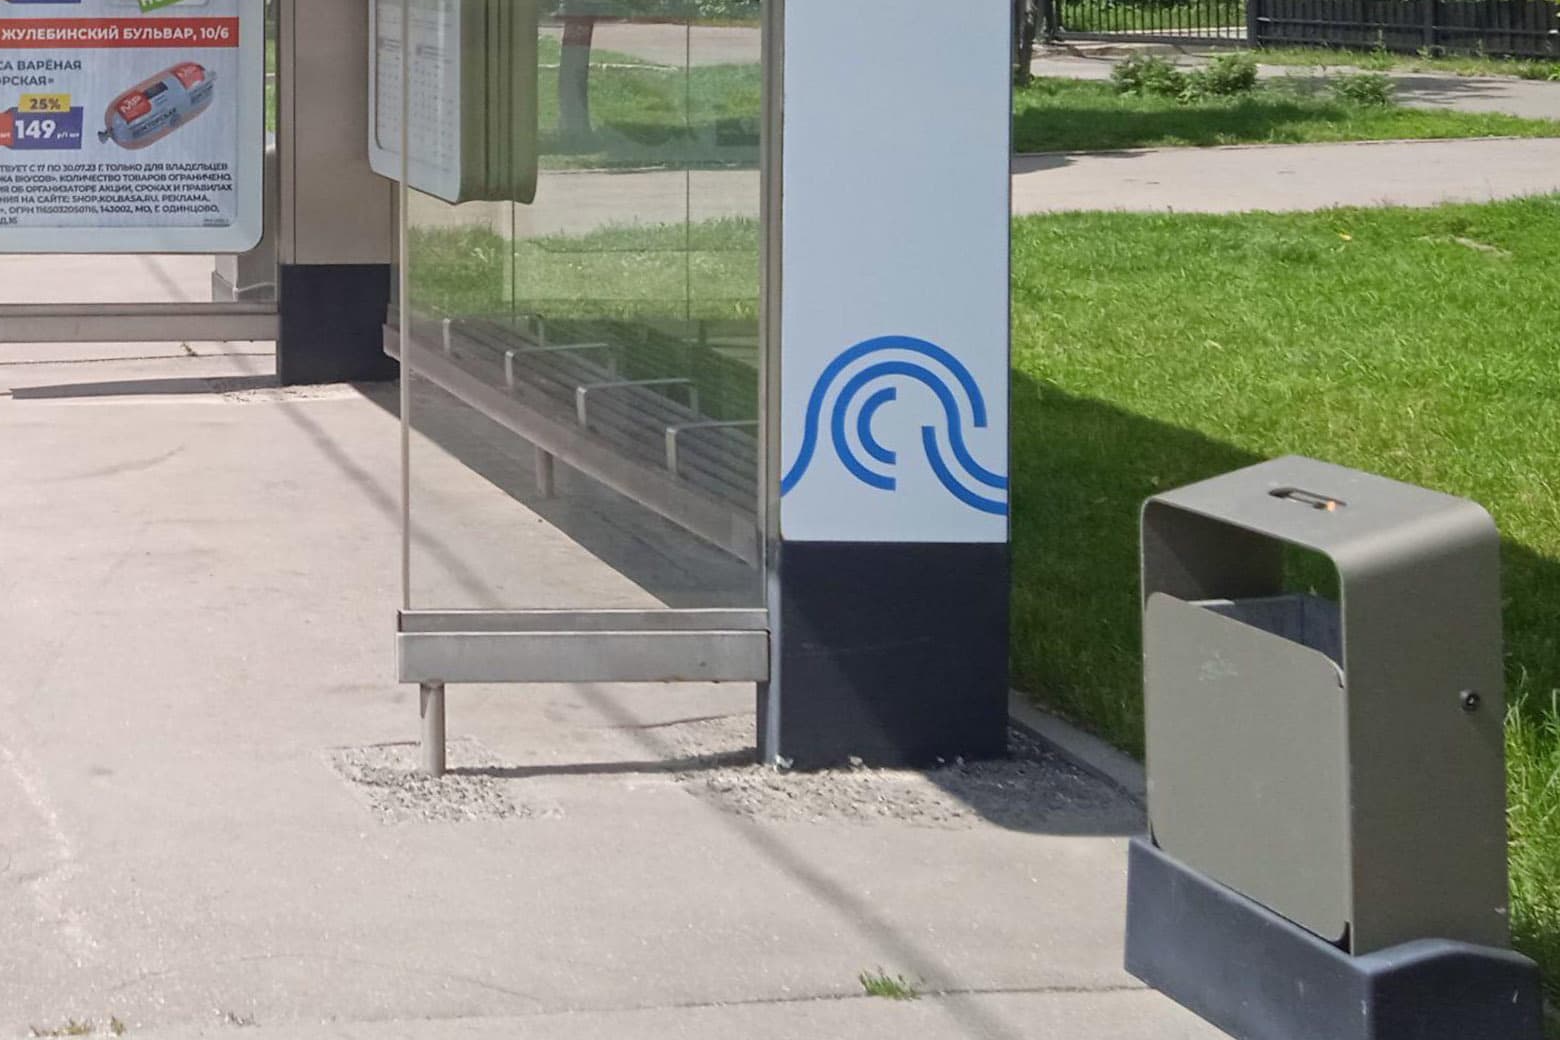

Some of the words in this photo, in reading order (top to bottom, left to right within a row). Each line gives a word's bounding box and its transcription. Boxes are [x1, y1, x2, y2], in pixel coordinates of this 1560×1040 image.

[2, 26, 119, 41] ЖУЛЕБИНСКИЙ
[123, 26, 197, 42] БУЛЬВАР,
[200, 26, 230, 41] 10/6
[17, 58, 82, 71] ВАРЁНАЯ
[29, 98, 61, 110] 25%
[15, 119, 56, 139] 149
[105, 163, 143, 172] ТОЛЬКО
[143, 163, 164, 173] ДЛЯ
[165, 162, 229, 173] ВЛАДЕЛЬЦЕВ
[59, 174, 121, 183] КОЛИЧЕСТВО
[123, 173, 167, 182] ТОВАРОВ
[26, 184, 97, 193] ОРГАНИЗАТОРЕ
[134, 183, 172, 192] СРОКАХ
[182, 183, 233, 192] ПРАВИЛАХ
[21, 195, 35, 203] НА
